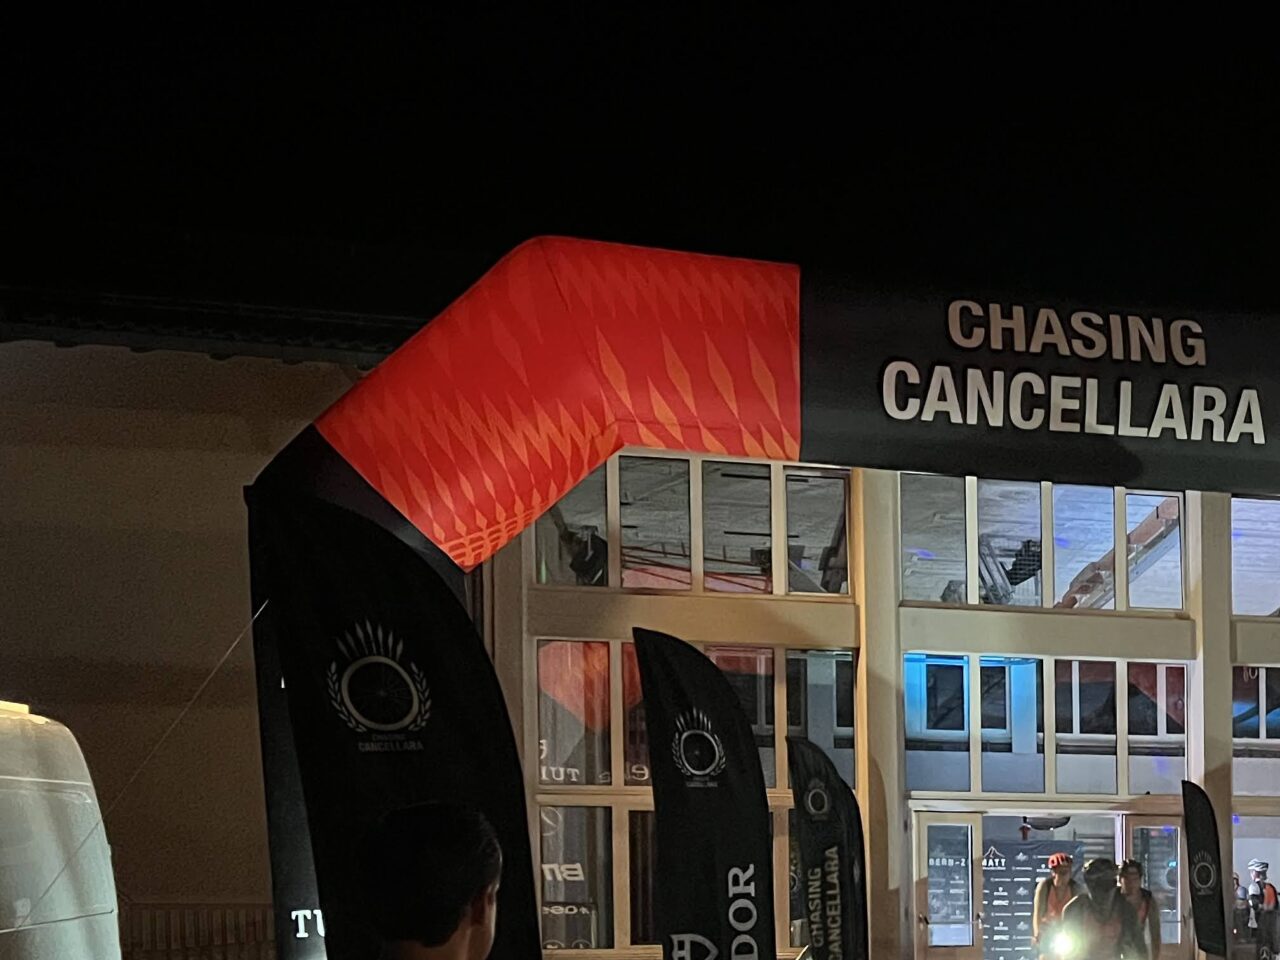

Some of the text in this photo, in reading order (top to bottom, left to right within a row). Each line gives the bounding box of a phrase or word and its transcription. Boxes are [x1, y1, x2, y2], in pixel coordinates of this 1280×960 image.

[948, 300, 1206, 366] CHASING
[882, 361, 1266, 445] CANCELLARA
[807, 866, 824, 948] CHASING
